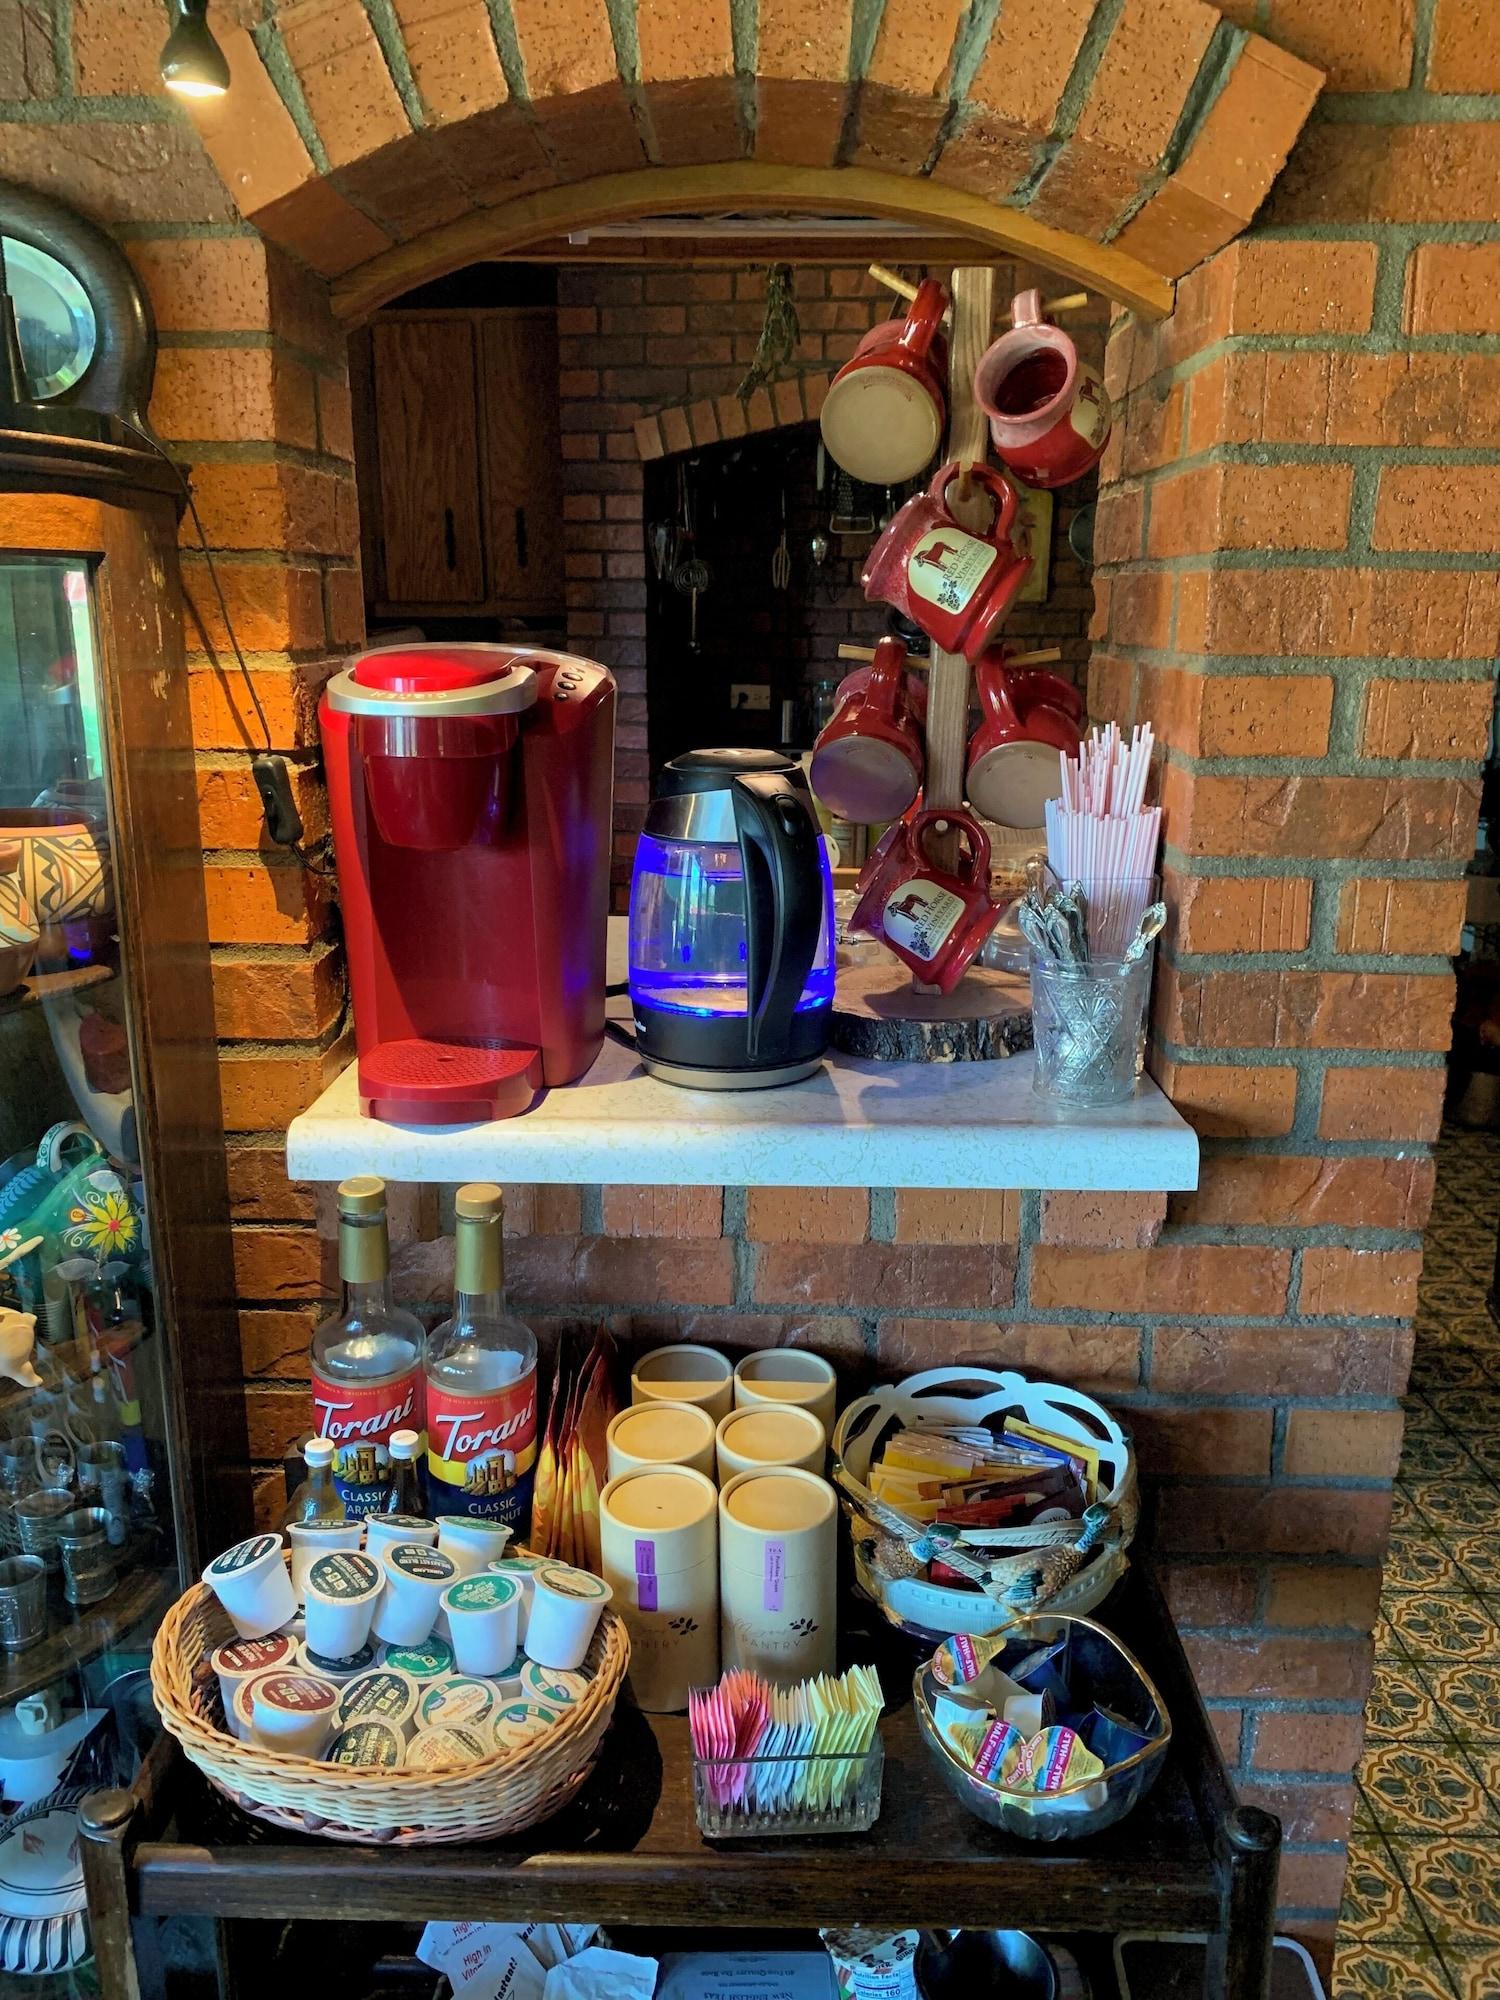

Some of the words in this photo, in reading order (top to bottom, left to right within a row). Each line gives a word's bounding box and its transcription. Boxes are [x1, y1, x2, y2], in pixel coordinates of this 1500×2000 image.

[943, 561, 960, 581] RED
[914, 914, 930, 932] RED
[928, 890, 946, 915] HORSE
[925, 896, 955, 931] VINEYARD
[315, 1387, 413, 1439] Torani
[436, 1388, 534, 1461] Torani
[344, 1502, 381, 1514] ARAM
[468, 1496, 516, 1514] CLASSIC
[989, 1721, 1005, 1748] HALF
[1050, 1764, 1063, 1790] HALF
[1059, 1732, 1072, 1757] HALF
[463, 1949, 482, 1966] High
[483, 1944, 492, 1955] in
[886, 1989, 900, 1997] 160
